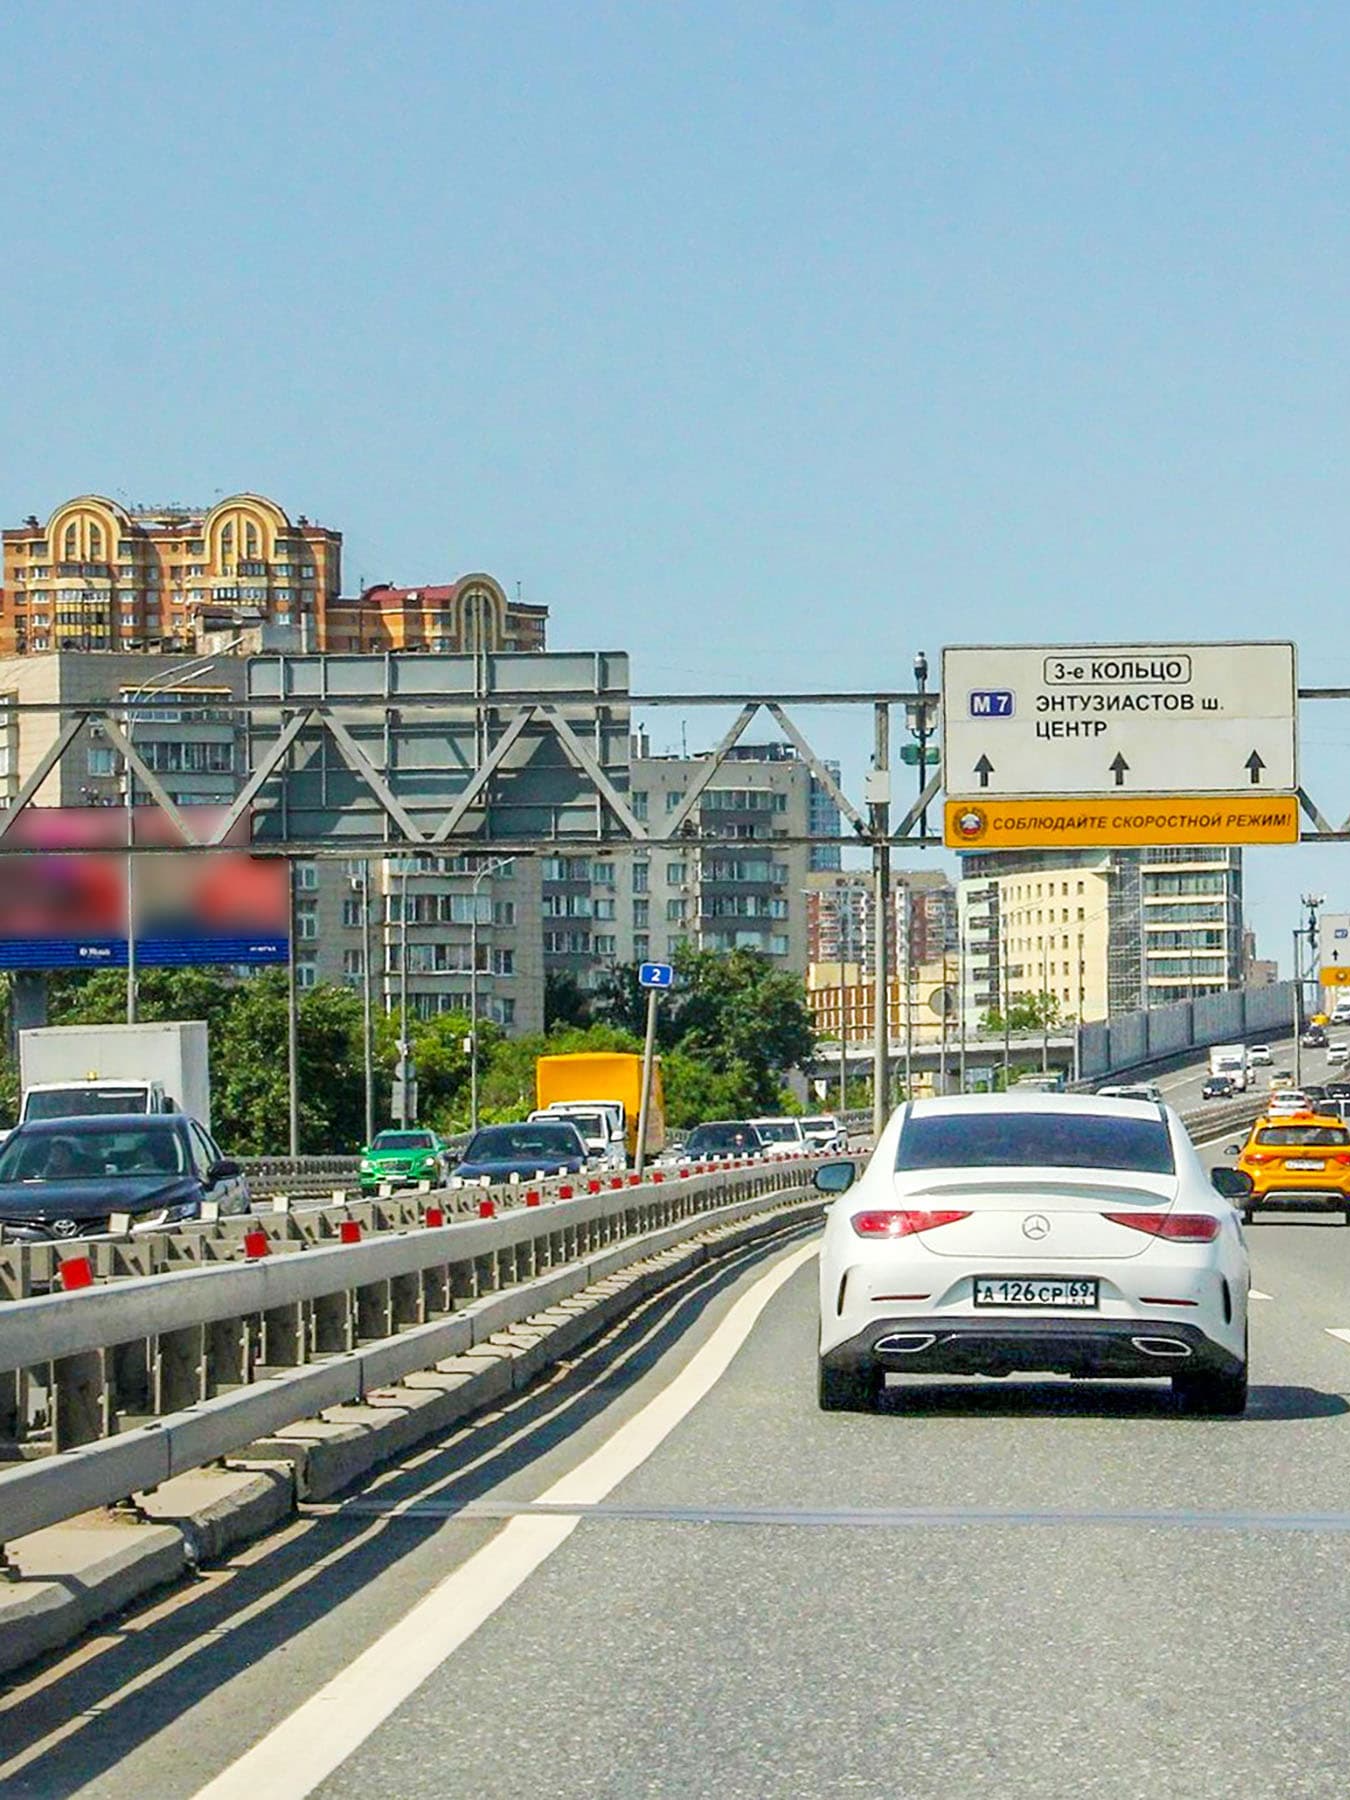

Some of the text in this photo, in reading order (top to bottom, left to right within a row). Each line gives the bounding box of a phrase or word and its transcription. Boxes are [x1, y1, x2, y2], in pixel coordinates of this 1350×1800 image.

[1053, 661, 1182, 682] 3-е КОЛЬЦО
[1035, 694, 1225, 712] ЭНТУЗИАСТОВ ш.
[1035, 721, 1107, 740] ЦЕНТР
[992, 812, 1292, 832] СОБЛЮДАЙТЕ СКОРОСТНОЙ РЕЖИМ!
[651, 968, 661, 982] 2
